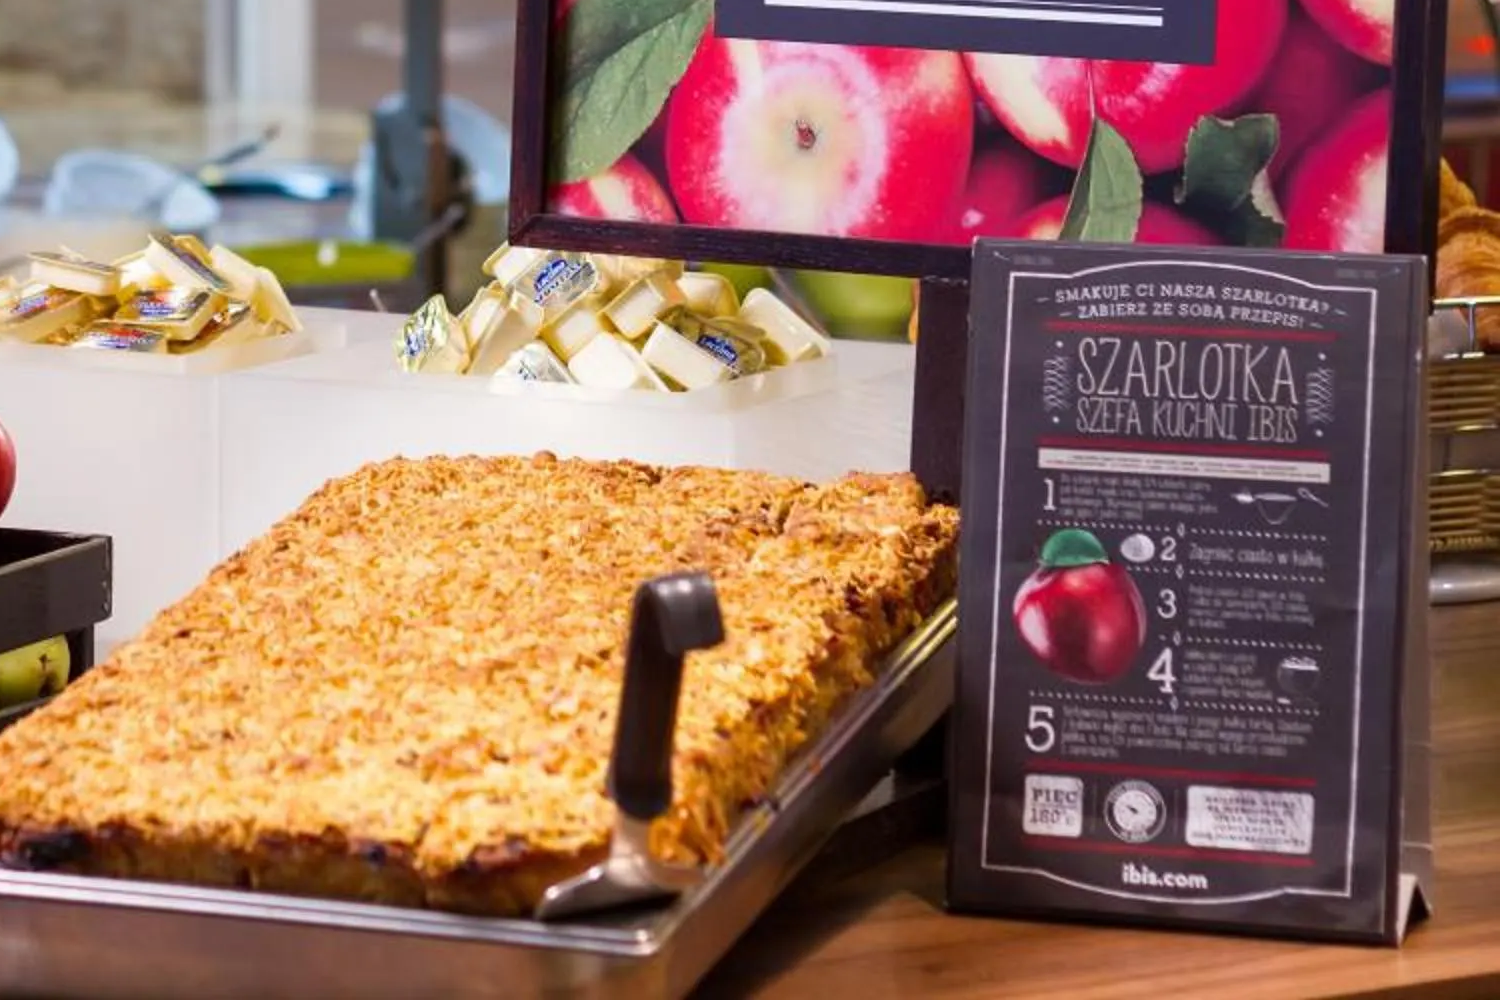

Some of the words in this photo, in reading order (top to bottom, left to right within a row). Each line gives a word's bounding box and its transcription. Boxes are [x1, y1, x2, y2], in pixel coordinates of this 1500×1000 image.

[1054, 283, 1131, 304] SMAKUJE
[1135, 283, 1155, 298] CI
[1160, 283, 1216, 300] NASZA
[1221, 286, 1330, 316] SZARLOTKA?
[1077, 302, 1148, 319] ZABIERZ
[1076, 336, 1300, 405] SZARLOTKA
[1075, 396, 1144, 436] SZEFA
[1152, 400, 1239, 441] KUCHNI
[1246, 404, 1299, 444] IBIS
[1043, 478, 1057, 511] 1
[1160, 536, 1177, 562] 2
[1156, 588, 1177, 619] 3
[1146, 647, 1177, 693] 4
[1025, 705, 1055, 752] 5
[1121, 861, 1209, 889] ibis.com
